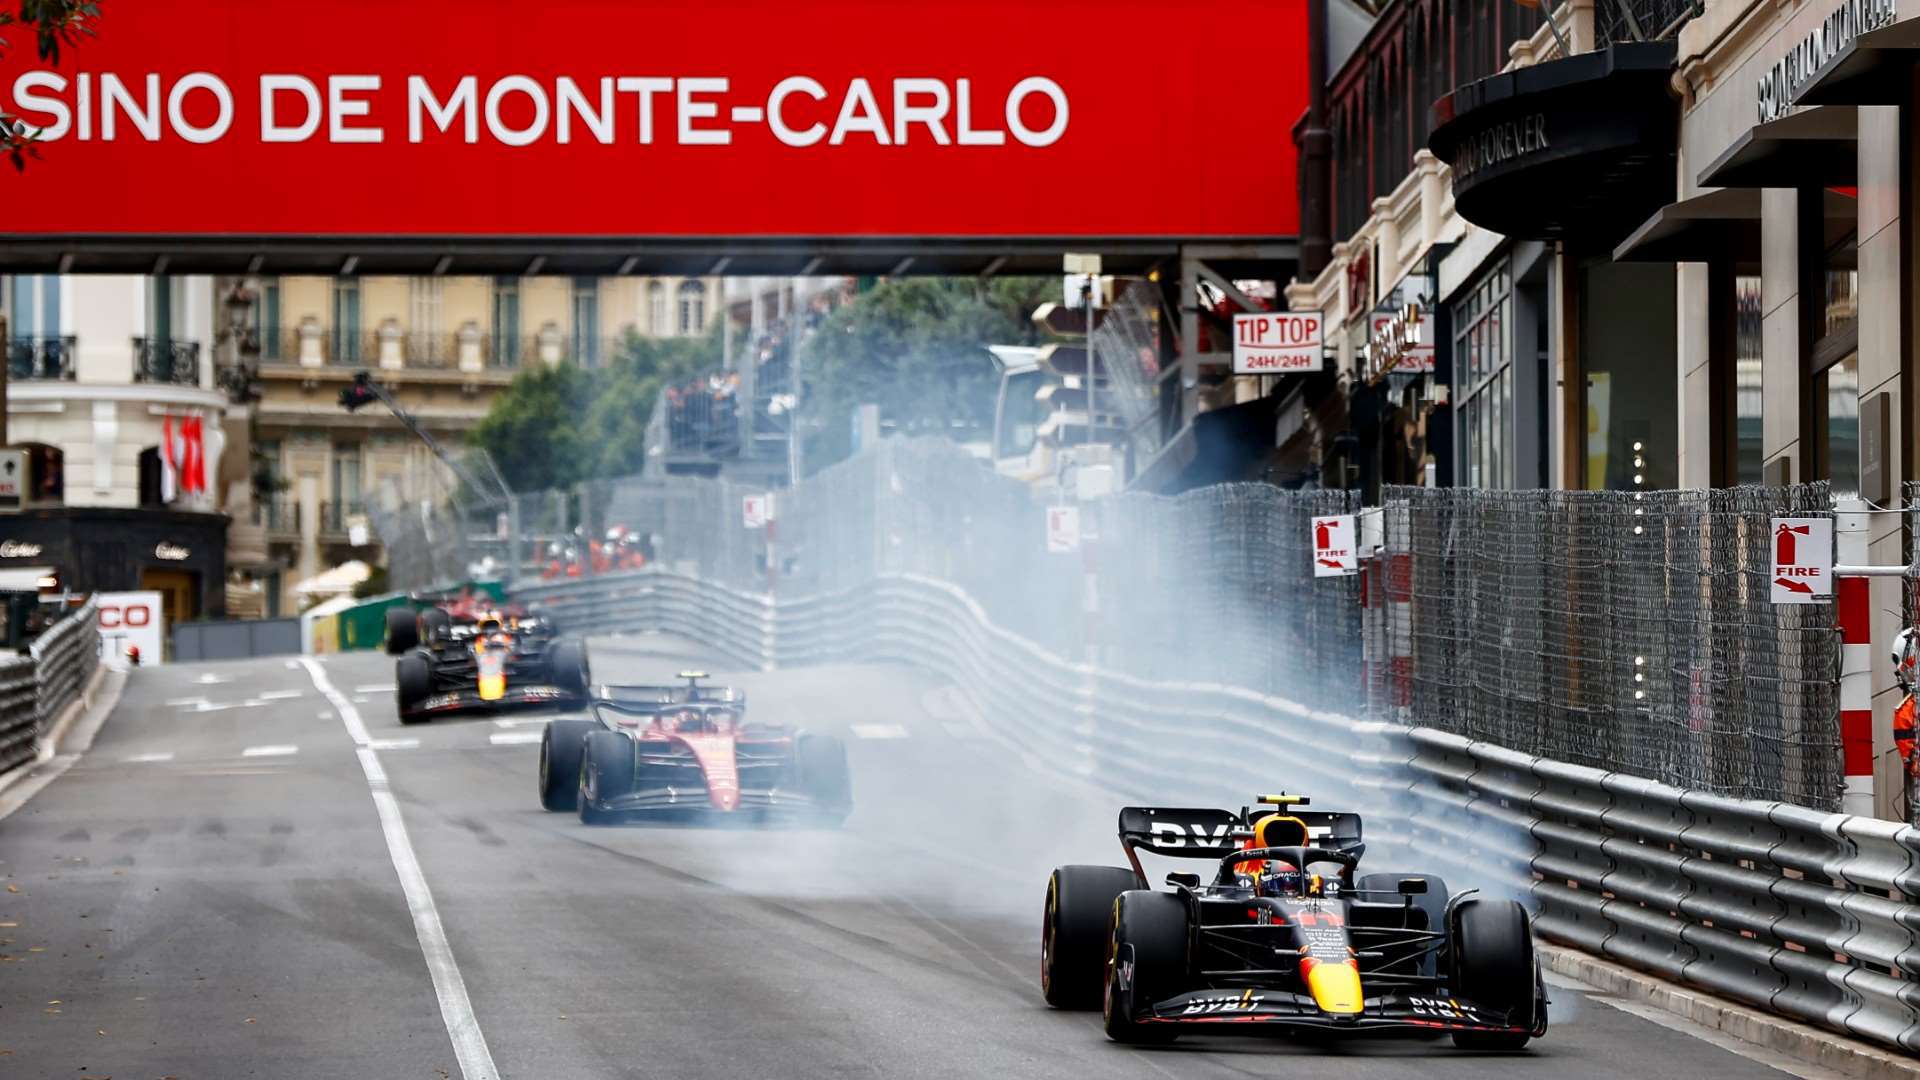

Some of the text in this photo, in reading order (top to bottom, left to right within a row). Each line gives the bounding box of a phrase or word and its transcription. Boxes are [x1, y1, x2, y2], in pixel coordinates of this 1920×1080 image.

[259, 74, 384, 143] DE
[407, 76, 1069, 147] MONTE-CARLO
[1480, 113, 1549, 168] FOREVER
[1236, 317, 1318, 343] TIP TOP
[1247, 354, 1312, 369] 24H/24H
[1776, 567, 1821, 577] FIRE
